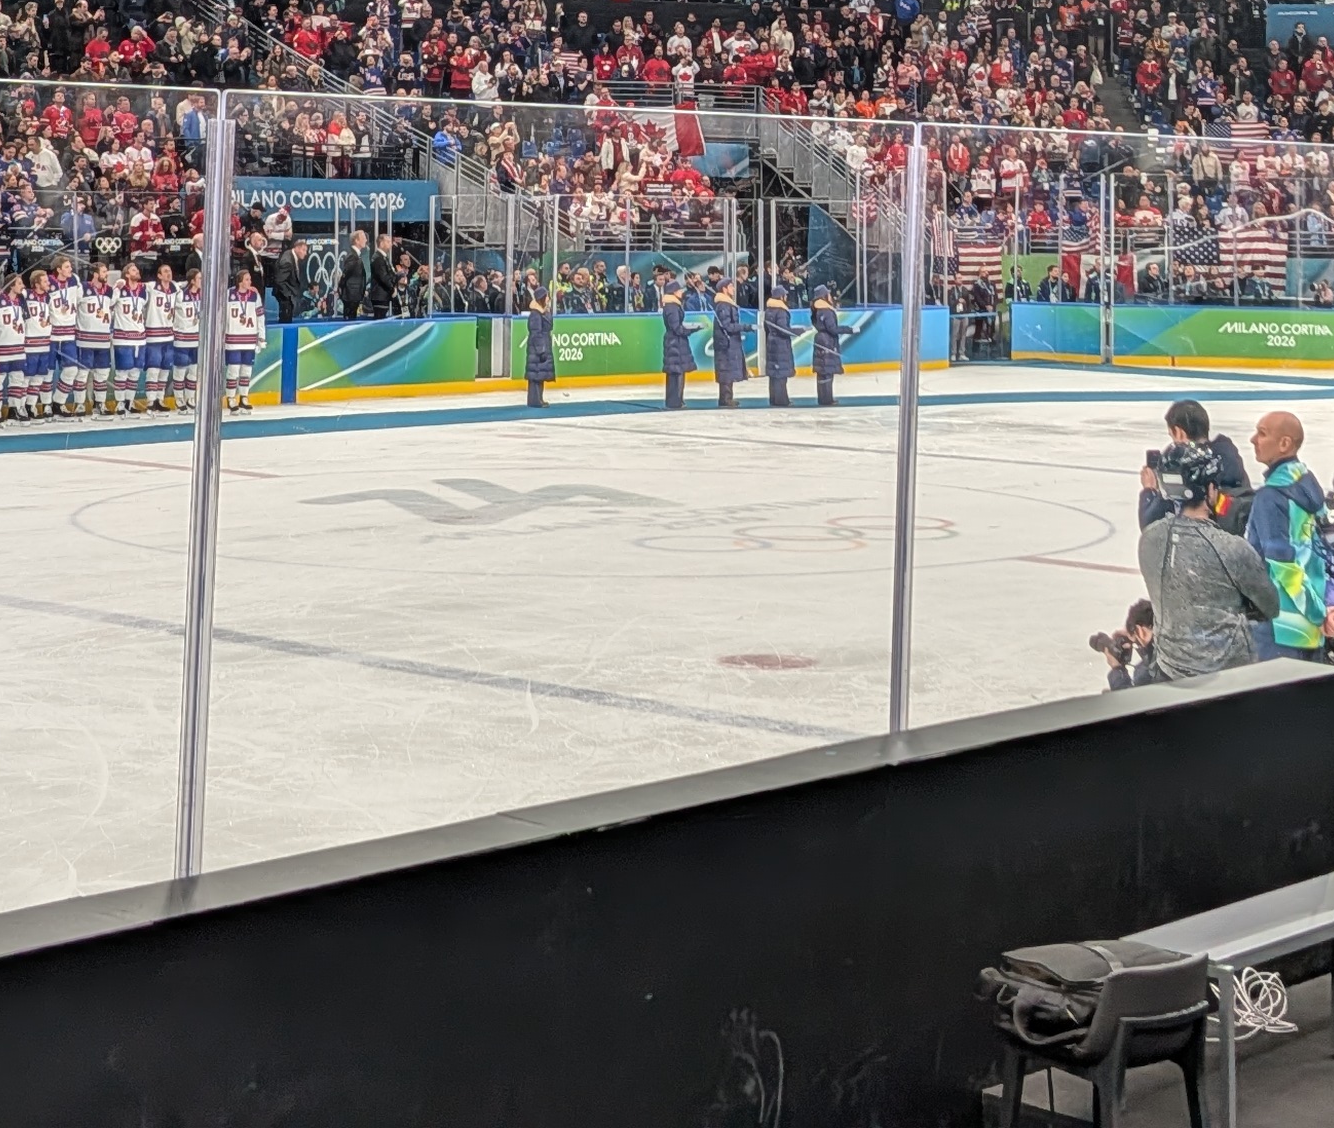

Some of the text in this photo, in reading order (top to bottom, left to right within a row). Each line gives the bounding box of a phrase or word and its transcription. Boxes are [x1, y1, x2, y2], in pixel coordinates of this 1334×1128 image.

[289, 190, 367, 210] CORTINA
[368, 192, 406, 210] 2026
[1218, 321, 1334, 337] MILANO CORTINA
[571, 332, 622, 347] CORTINA
[1266, 334, 1297, 347] 2026
[558, 347, 584, 361] 2026
